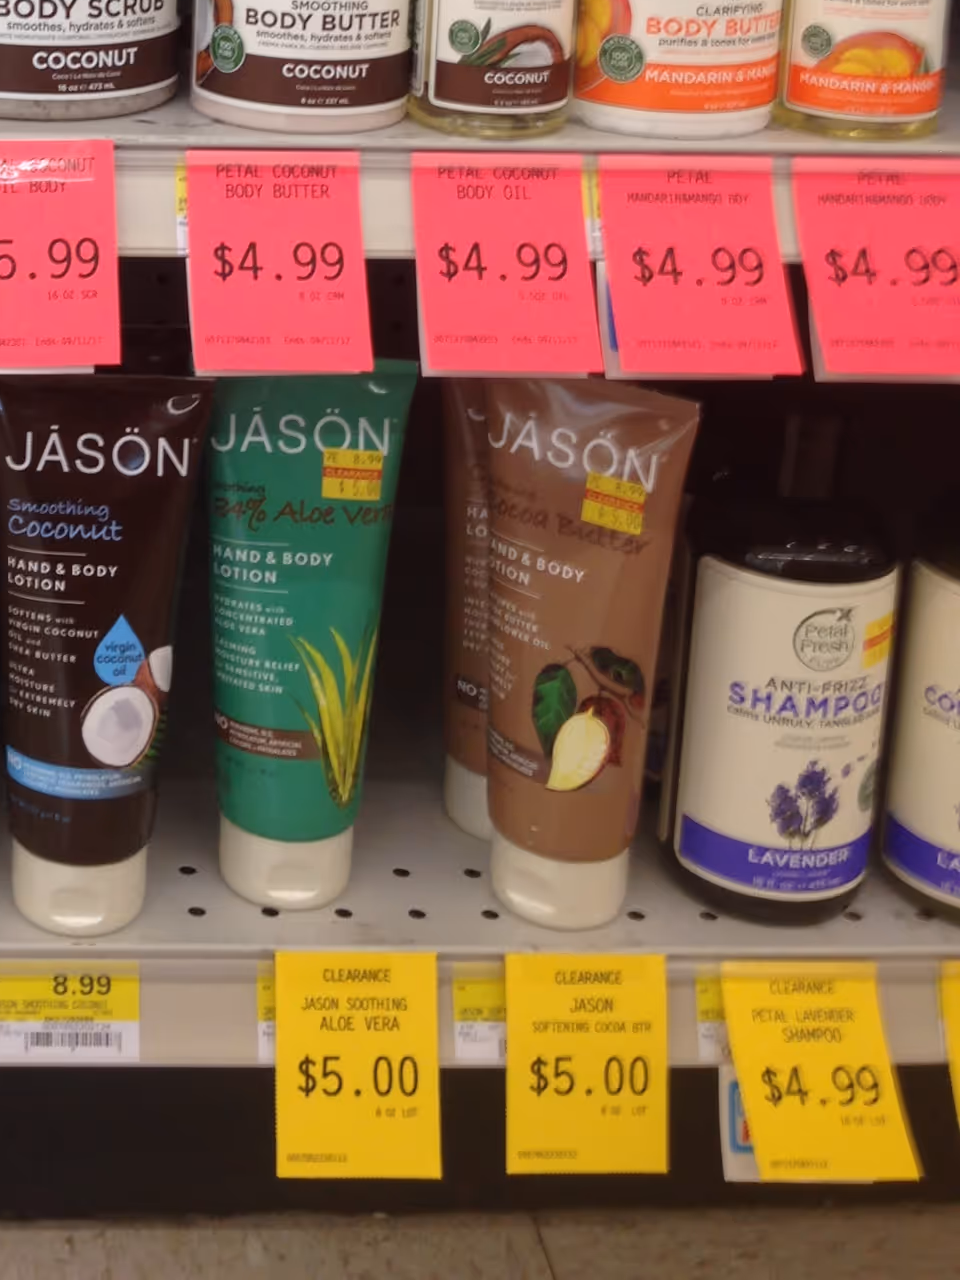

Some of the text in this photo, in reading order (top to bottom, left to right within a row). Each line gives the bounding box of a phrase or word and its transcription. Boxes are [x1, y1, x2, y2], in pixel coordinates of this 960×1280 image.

[291, 0, 368, 12] SMOOTHING
[696, 3, 763, 17] CLARIFYING
[68, 19, 115, 33] hydrates
[245, 8, 400, 32] BODY BUTTER
[646, 15, 716, 38] BODY
[32, 47, 138, 71] COCONUT
[282, 63, 370, 80] COCONUT
[484, 71, 549, 85] COCONUT
[645, 70, 734, 85] MANDARIN
[216, 164, 338, 179] PETAL COCONUT
[225, 184, 330, 199] BODY BUTTER
[457, 185, 532, 200] BODY OIL
[213, 241, 345, 282] $4.99
[438, 241, 568, 283] $4.99
[632, 246, 765, 287] $4.99
[825, 247, 960, 287] $4.99
[7, 498, 110, 521] Smoothing
[8, 515, 123, 541] Coconut
[8, 556, 118, 578] HAND & BODY
[214, 563, 277, 583] LOTION
[536, 559, 585, 584] BODY
[8, 573, 66, 592] LOTION
[105, 641, 136, 655] virgin
[96, 653, 144, 664] coconut
[765, 676, 868, 694] ANTI-FRIZZ
[748, 848, 849, 869] LAVENDER
[323, 969, 391, 983] CLEARANCE
[555, 971, 622, 985] CLEARANCE
[53, 974, 112, 997] 8.99
[301, 997, 407, 1011] JASON SOOTHING
[570, 998, 613, 1013] JASON
[320, 1016, 400, 1031] ALOE VERA
[782, 1028, 842, 1043] SHAMPOO
[298, 1054, 419, 1098] $5.00
[529, 1056, 649, 1097] $5.00
[761, 1065, 881, 1108] $4.99
